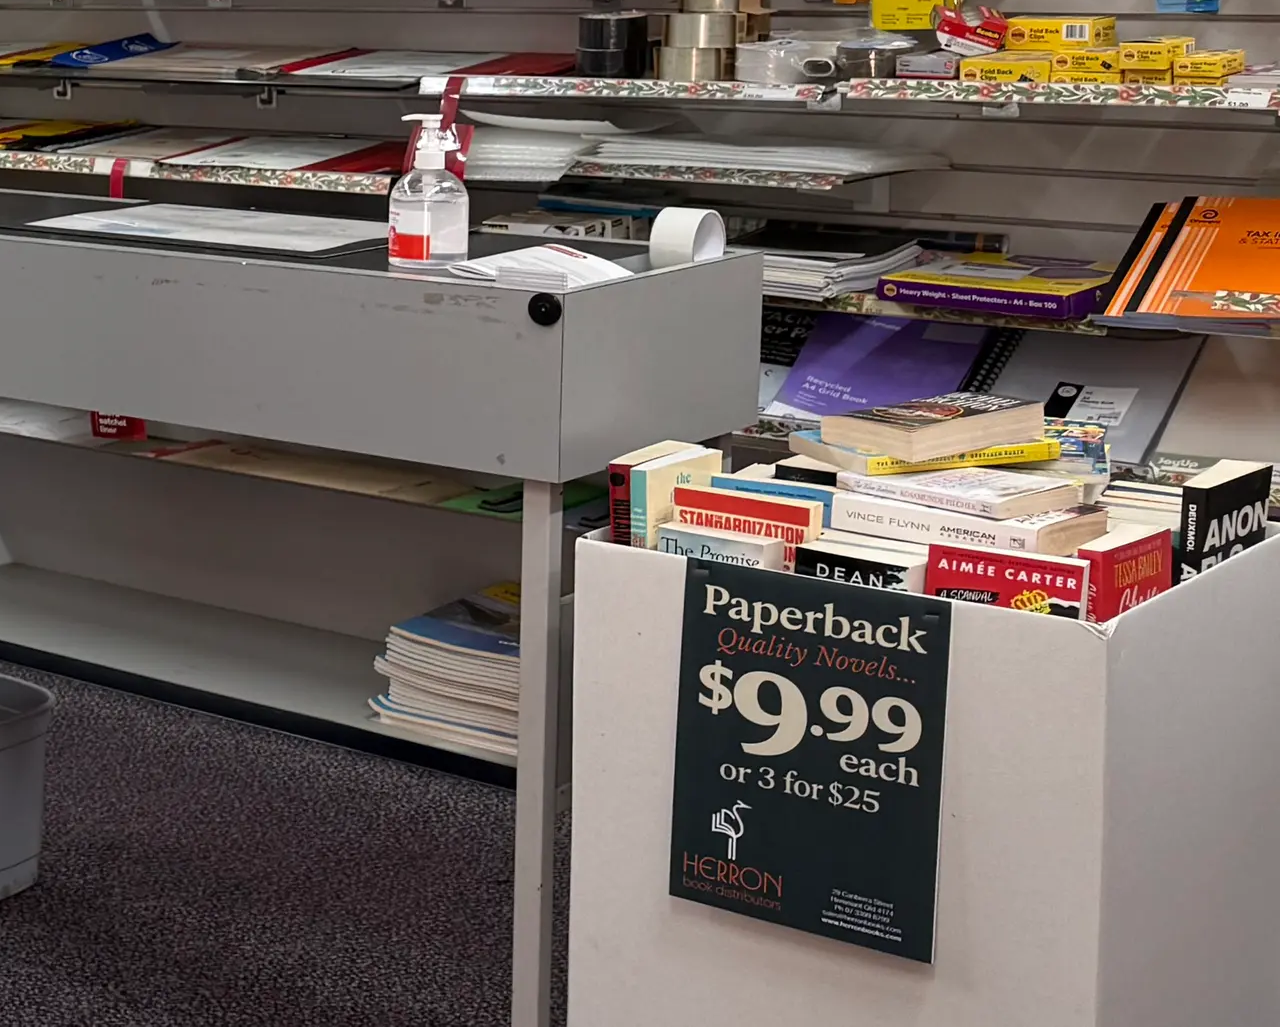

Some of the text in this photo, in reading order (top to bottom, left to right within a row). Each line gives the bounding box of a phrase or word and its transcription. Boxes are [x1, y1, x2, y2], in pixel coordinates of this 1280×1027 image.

[976, 27, 999, 39] Scotch
[899, 288, 921, 298] Heavy
[922, 290, 946, 299] Weight
[952, 293, 970, 301] Sheet
[973, 294, 1007, 305] Protectors
[802, 382, 868, 404] A4 Grid Book
[807, 376, 851, 392] Recycled
[846, 510, 996, 540] VINCE FLYNN AMERICAN
[1203, 498, 1269, 552] ANON
[661, 537, 760, 567] The Promise
[816, 563, 883, 588] DEAN
[938, 558, 1077, 590] AIMÉE CARTER
[1114, 551, 1162, 588] TESSA BAILEY
[703, 584, 927, 654] Paperback
[717, 628, 916, 685] Quality Novels...
[698, 659, 923, 756] $9.99
[839, 754, 919, 787] each
[720, 764, 880, 813] or 3 for $25
[683, 852, 782, 897] HERRON
[683, 877, 781, 911] book distributors
